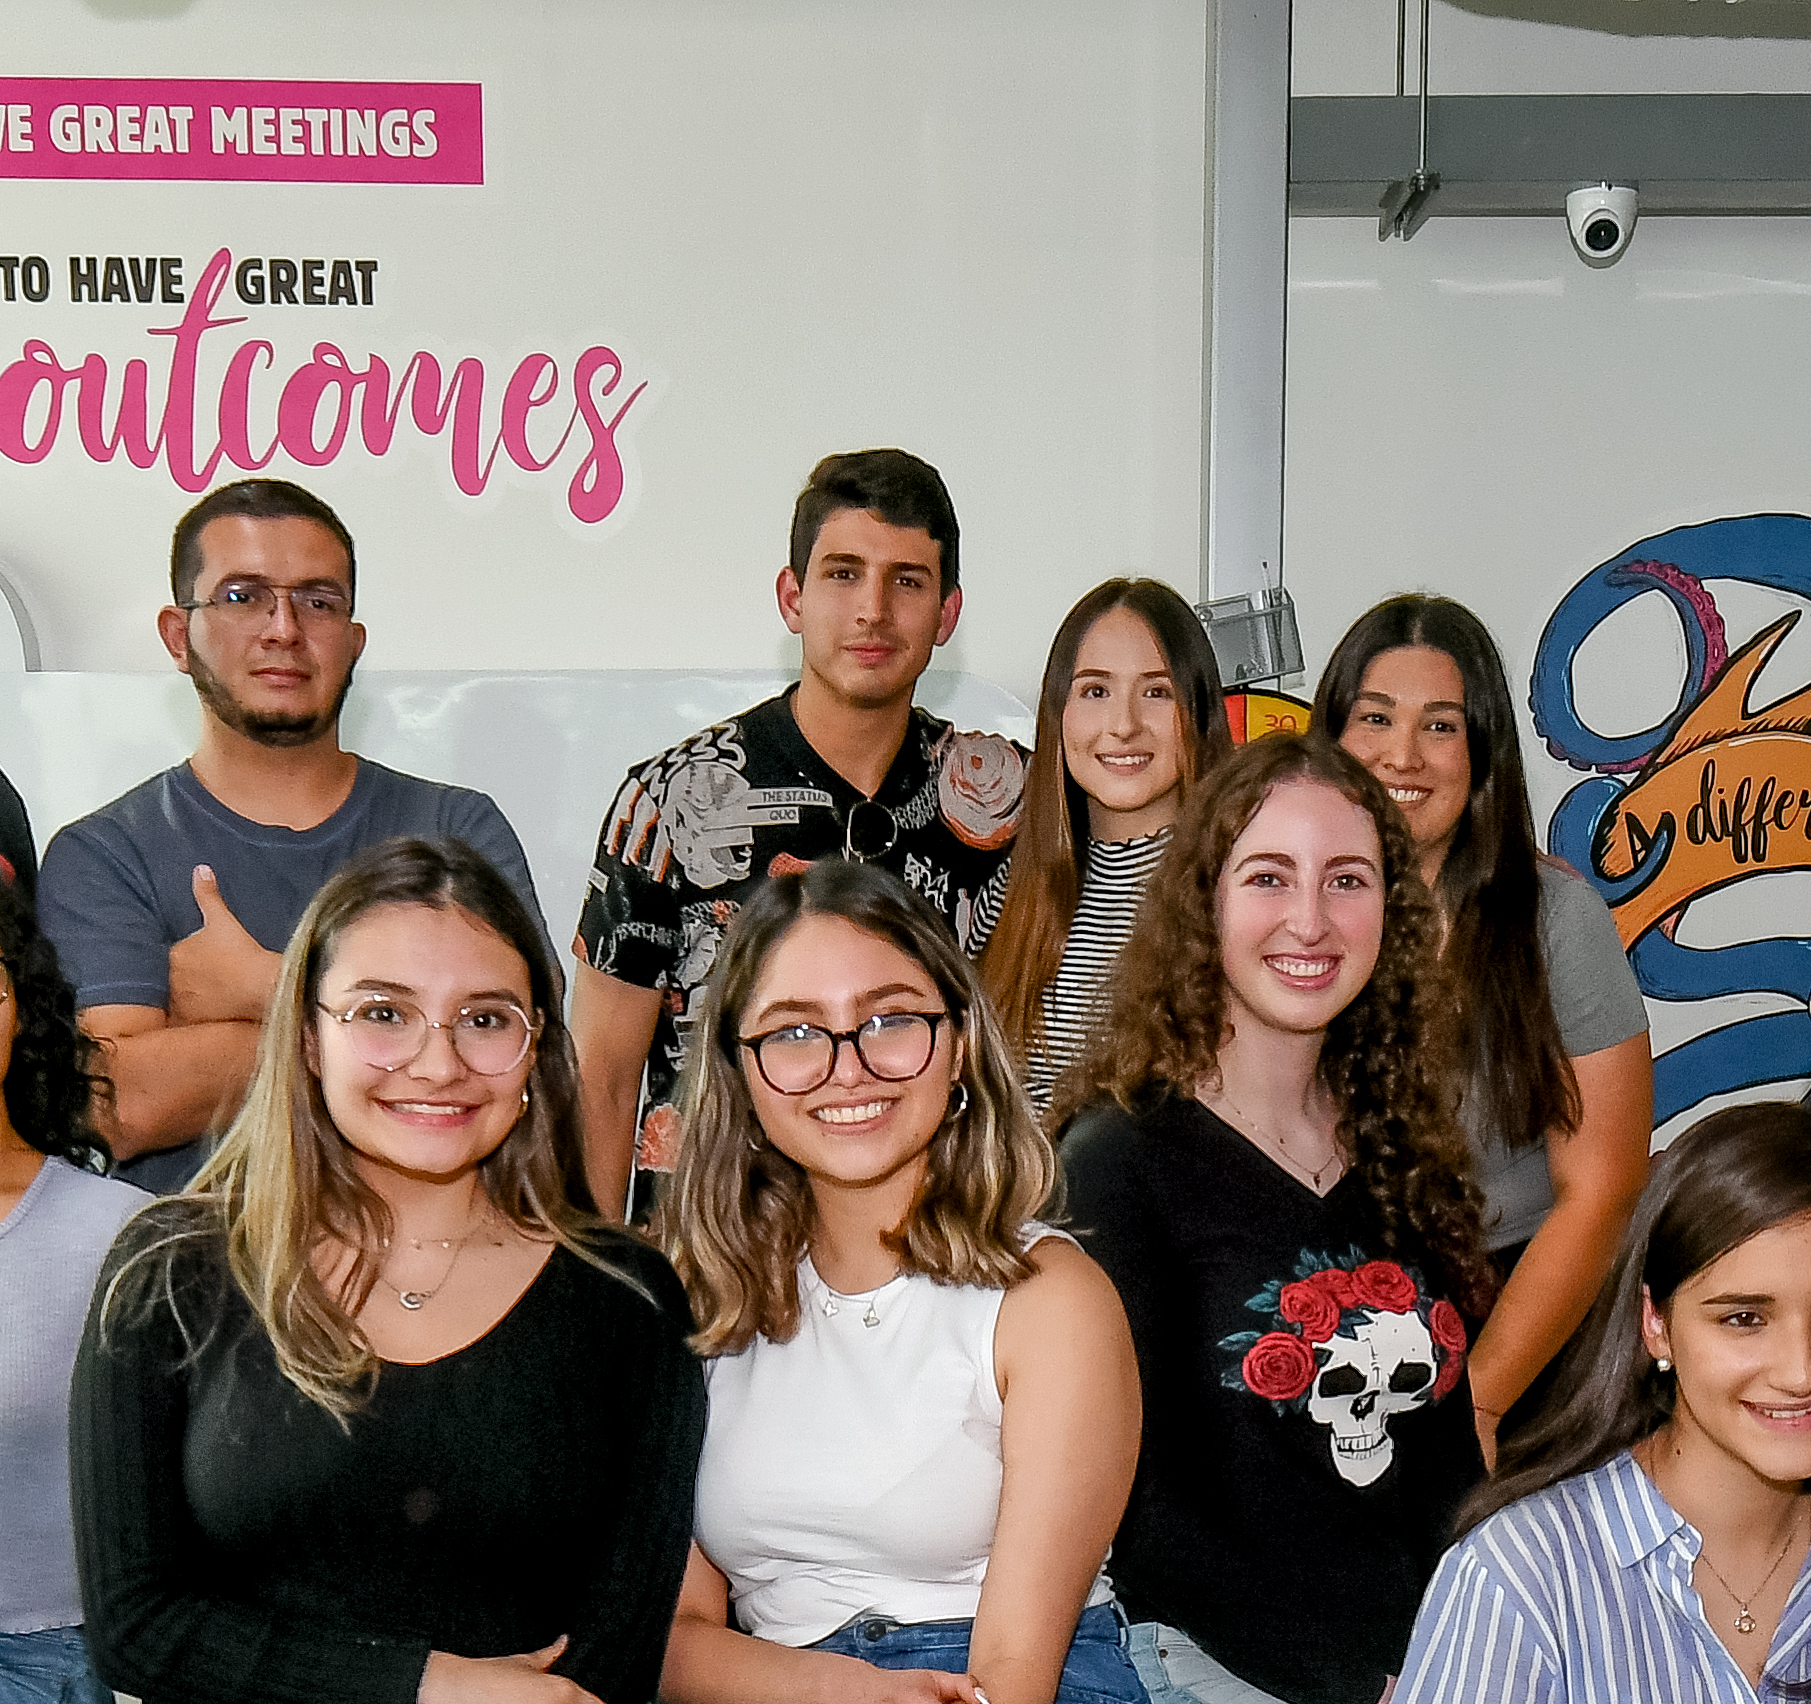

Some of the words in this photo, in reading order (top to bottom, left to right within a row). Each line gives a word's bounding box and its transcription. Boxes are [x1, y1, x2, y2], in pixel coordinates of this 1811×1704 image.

[49, 104, 194, 155] GREAT
[210, 106, 439, 158] MEETINGS
[68, 256, 185, 304] HAVE
[235, 258, 379, 306] GREAT
[762, 790, 784, 803] THE
[786, 790, 828, 802] STATUS
